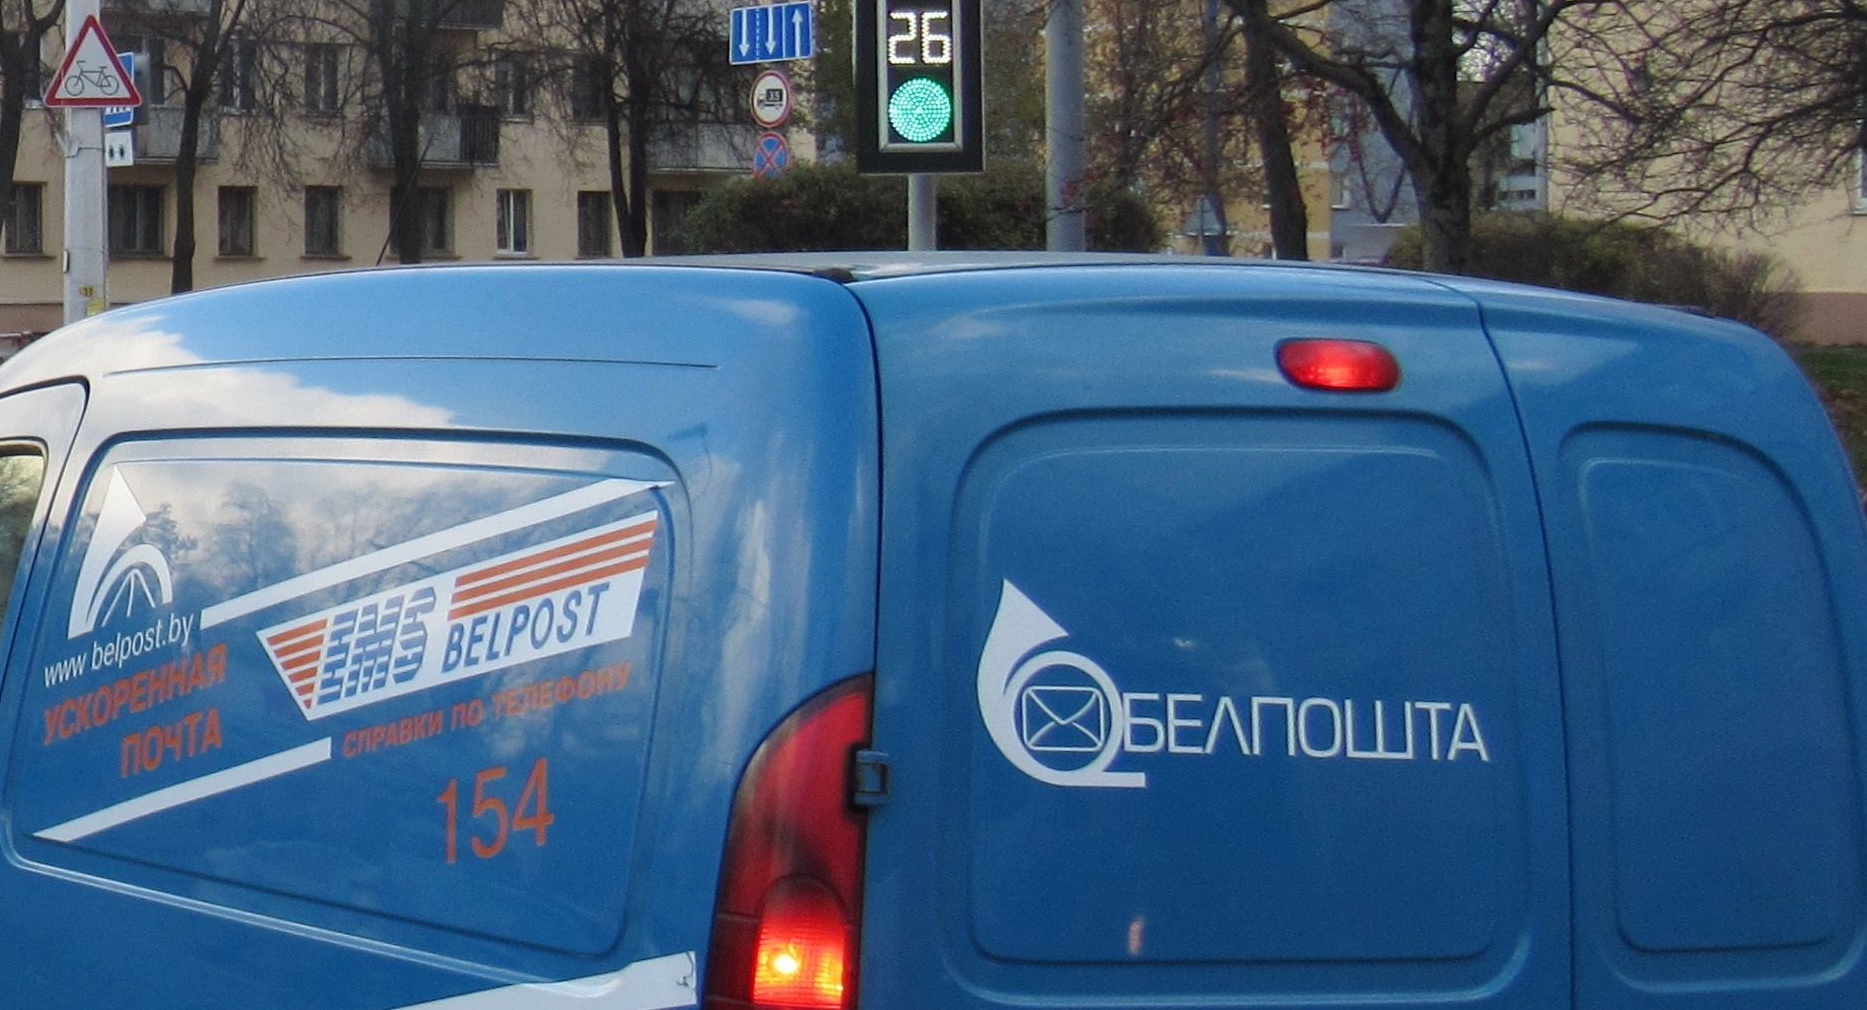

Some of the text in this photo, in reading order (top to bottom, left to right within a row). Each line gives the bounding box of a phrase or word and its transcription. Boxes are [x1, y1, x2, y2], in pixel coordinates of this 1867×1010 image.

[888, 11, 952, 64] 26
[316, 582, 611, 707] EMS BELPOST
[44, 643, 227, 746] УСКОРЕННАЯ
[120, 707, 223, 778] ПОЧТА
[341, 660, 632, 758] СПРАВКИ ПО ТЕЛЕФОНУ
[1122, 691, 1491, 763] БЕЛПОШТА
[436, 756, 555, 864] 154
